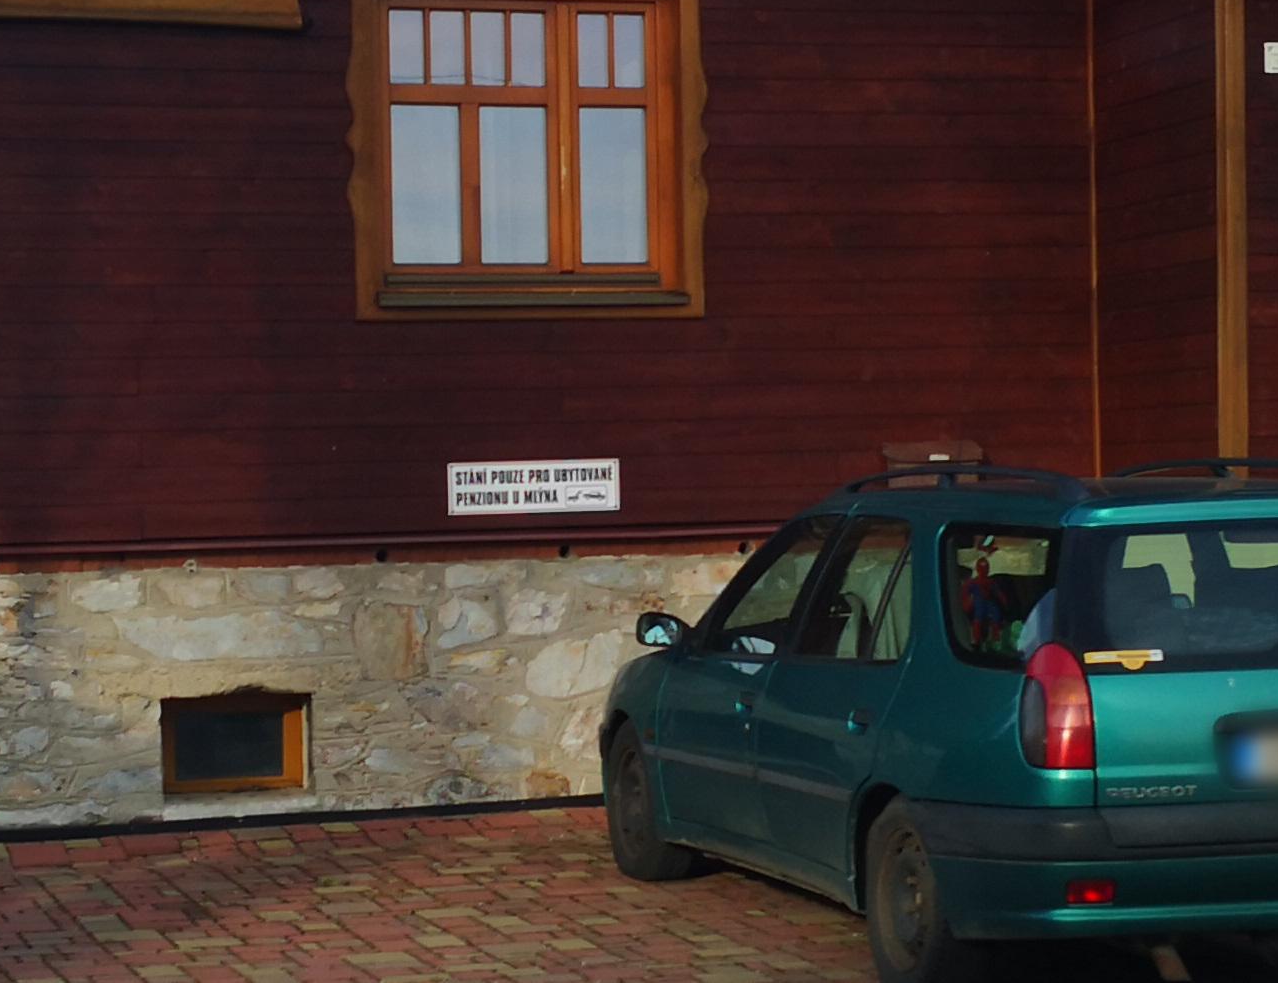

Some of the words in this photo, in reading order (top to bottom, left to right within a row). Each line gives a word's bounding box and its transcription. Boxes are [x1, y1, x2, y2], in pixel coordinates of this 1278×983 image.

[455, 468, 487, 486] STÁNÍ
[491, 469, 524, 484] POUZE
[528, 469, 550, 483] PRO
[554, 466, 613, 483] UBYTOVANÉ
[456, 491, 508, 506] PENZIONU
[513, 491, 519, 504] U
[524, 487, 558, 504] MLÝNA
[1106, 784, 1198, 800] PEUGEOT
